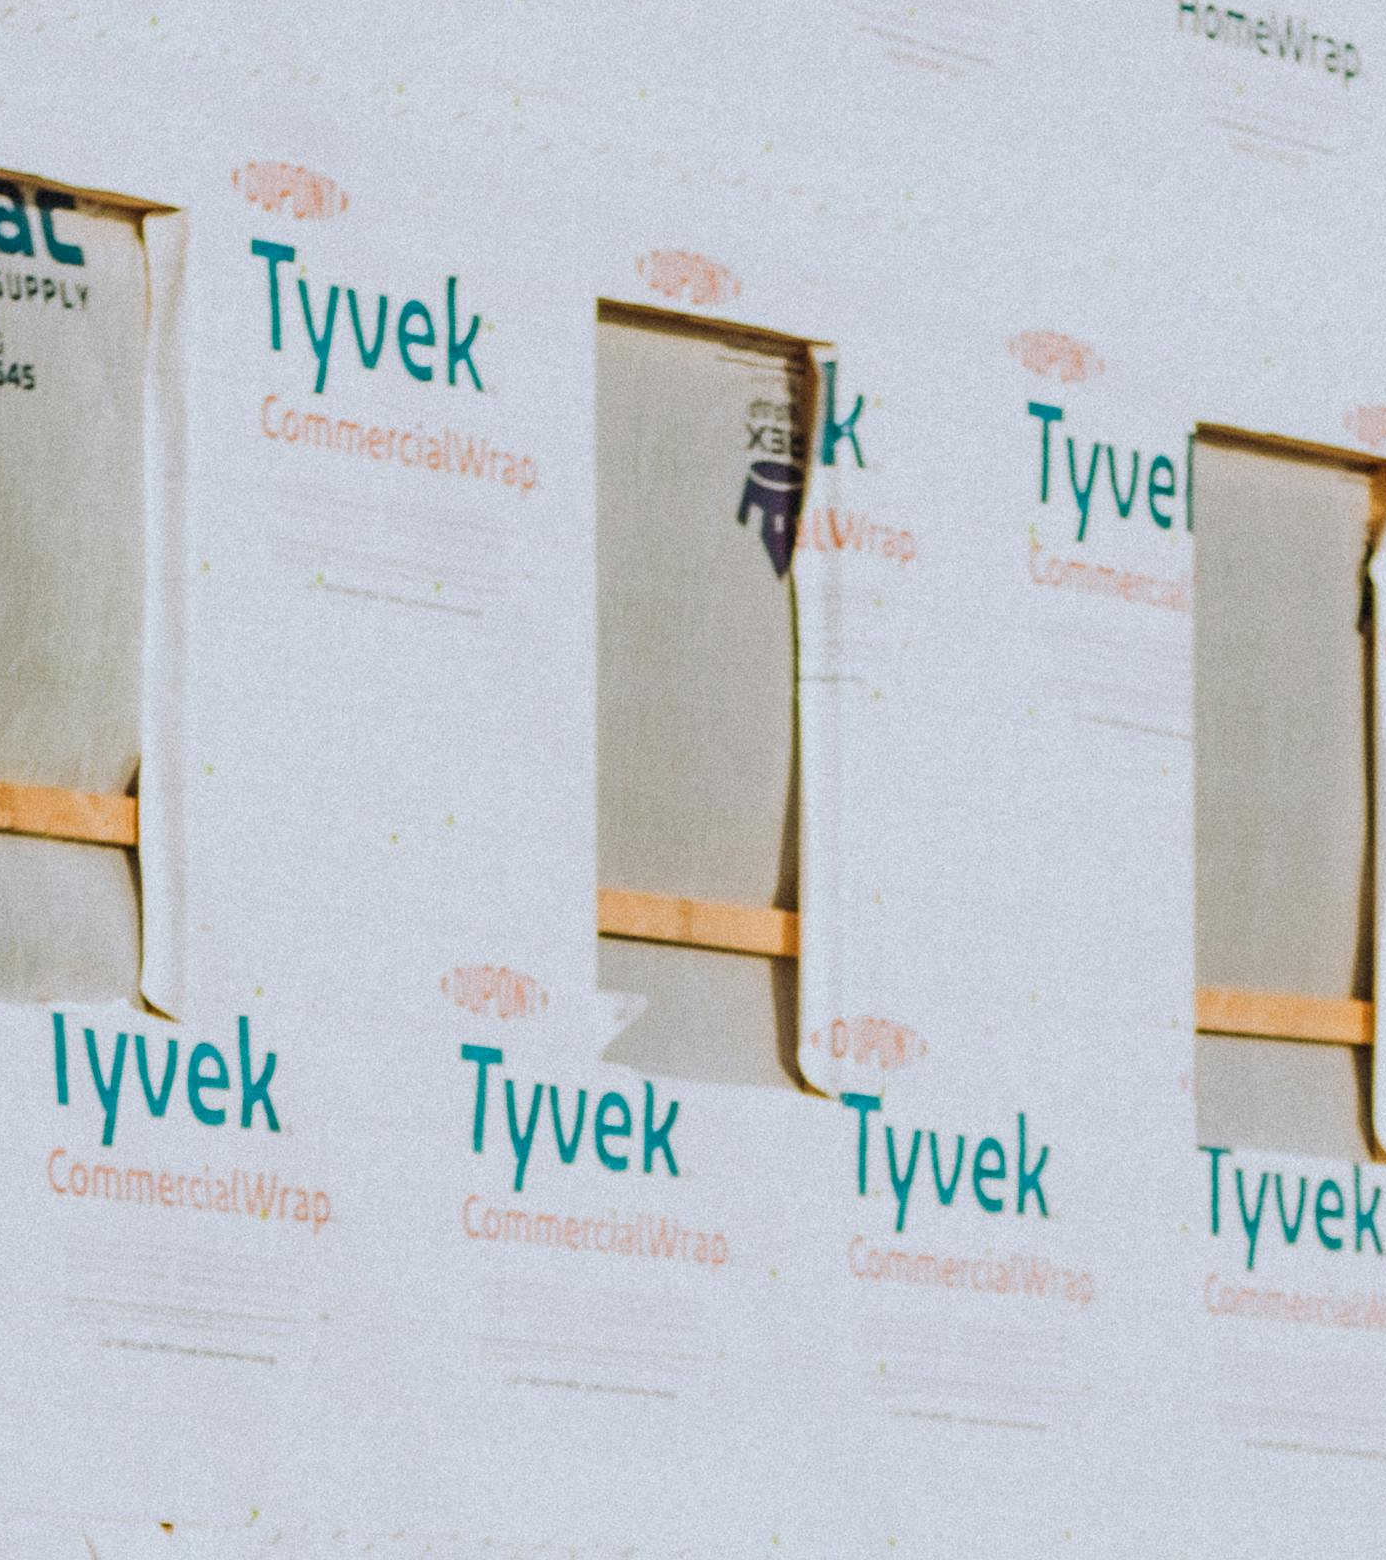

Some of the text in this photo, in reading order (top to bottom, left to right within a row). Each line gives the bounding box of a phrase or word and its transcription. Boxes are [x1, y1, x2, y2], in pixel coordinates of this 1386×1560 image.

[251, 238, 485, 394] Tyvek
[260, 394, 537, 496] CommercialWrap
[462, 1044, 680, 1192] Tyvek
[840, 1092, 1049, 1233] Tyvek
[47, 1149, 332, 1233] CommercialWrap
[1197, 1146, 1383, 1270] Tyvek
